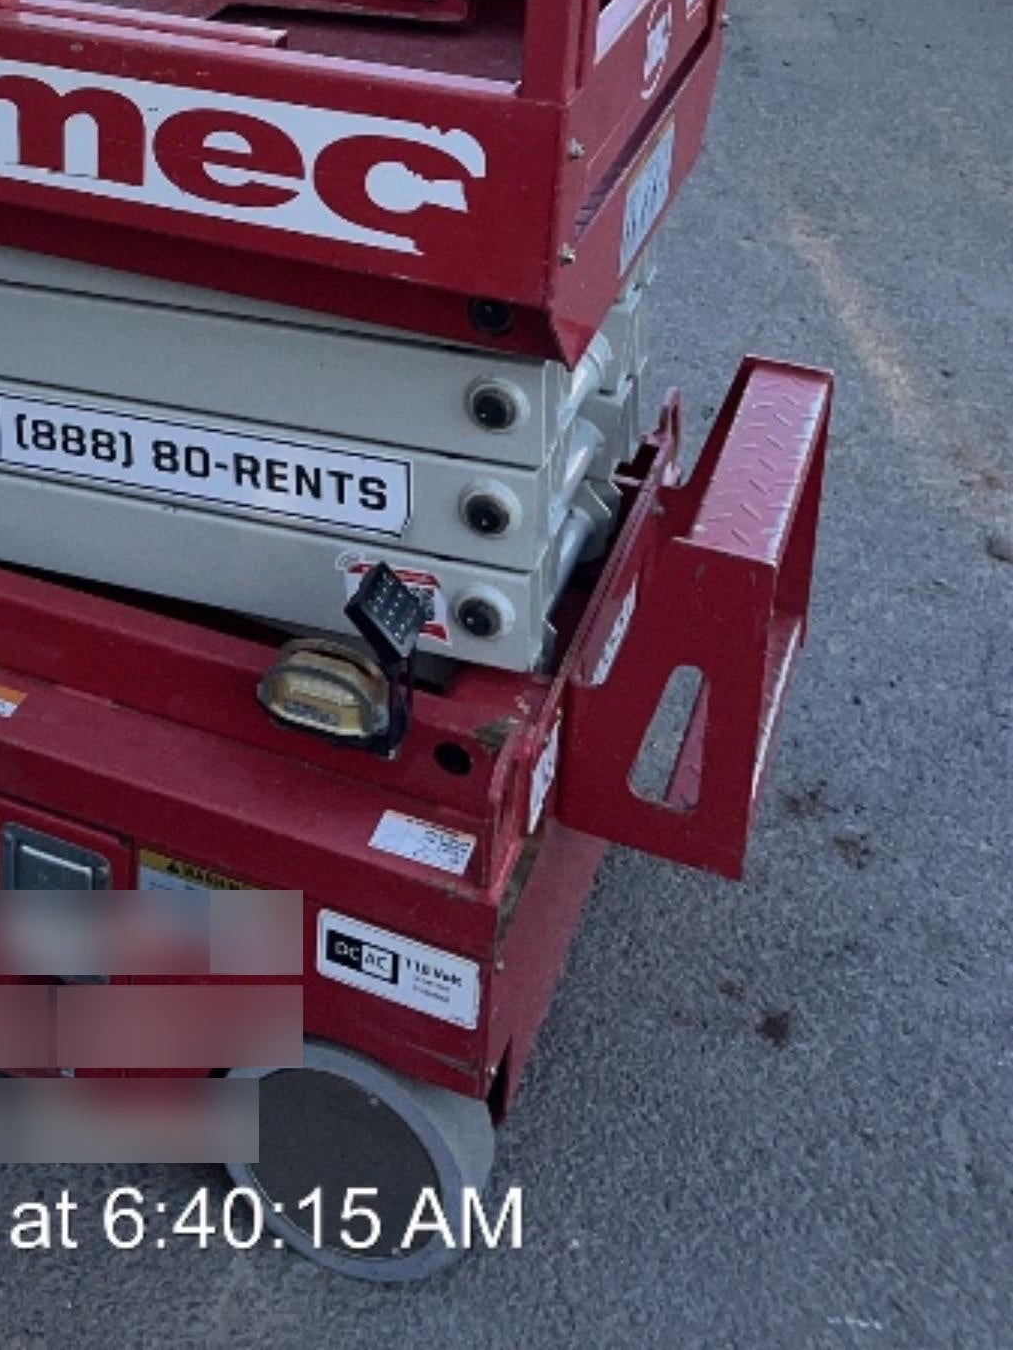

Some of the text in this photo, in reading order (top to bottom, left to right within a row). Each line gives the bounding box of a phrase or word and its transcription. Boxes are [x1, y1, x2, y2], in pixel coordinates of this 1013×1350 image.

[15, 413, 387, 511] (888) 80-RENTS
[334, 941, 360, 961] DC
[364, 953, 388, 972] AC
